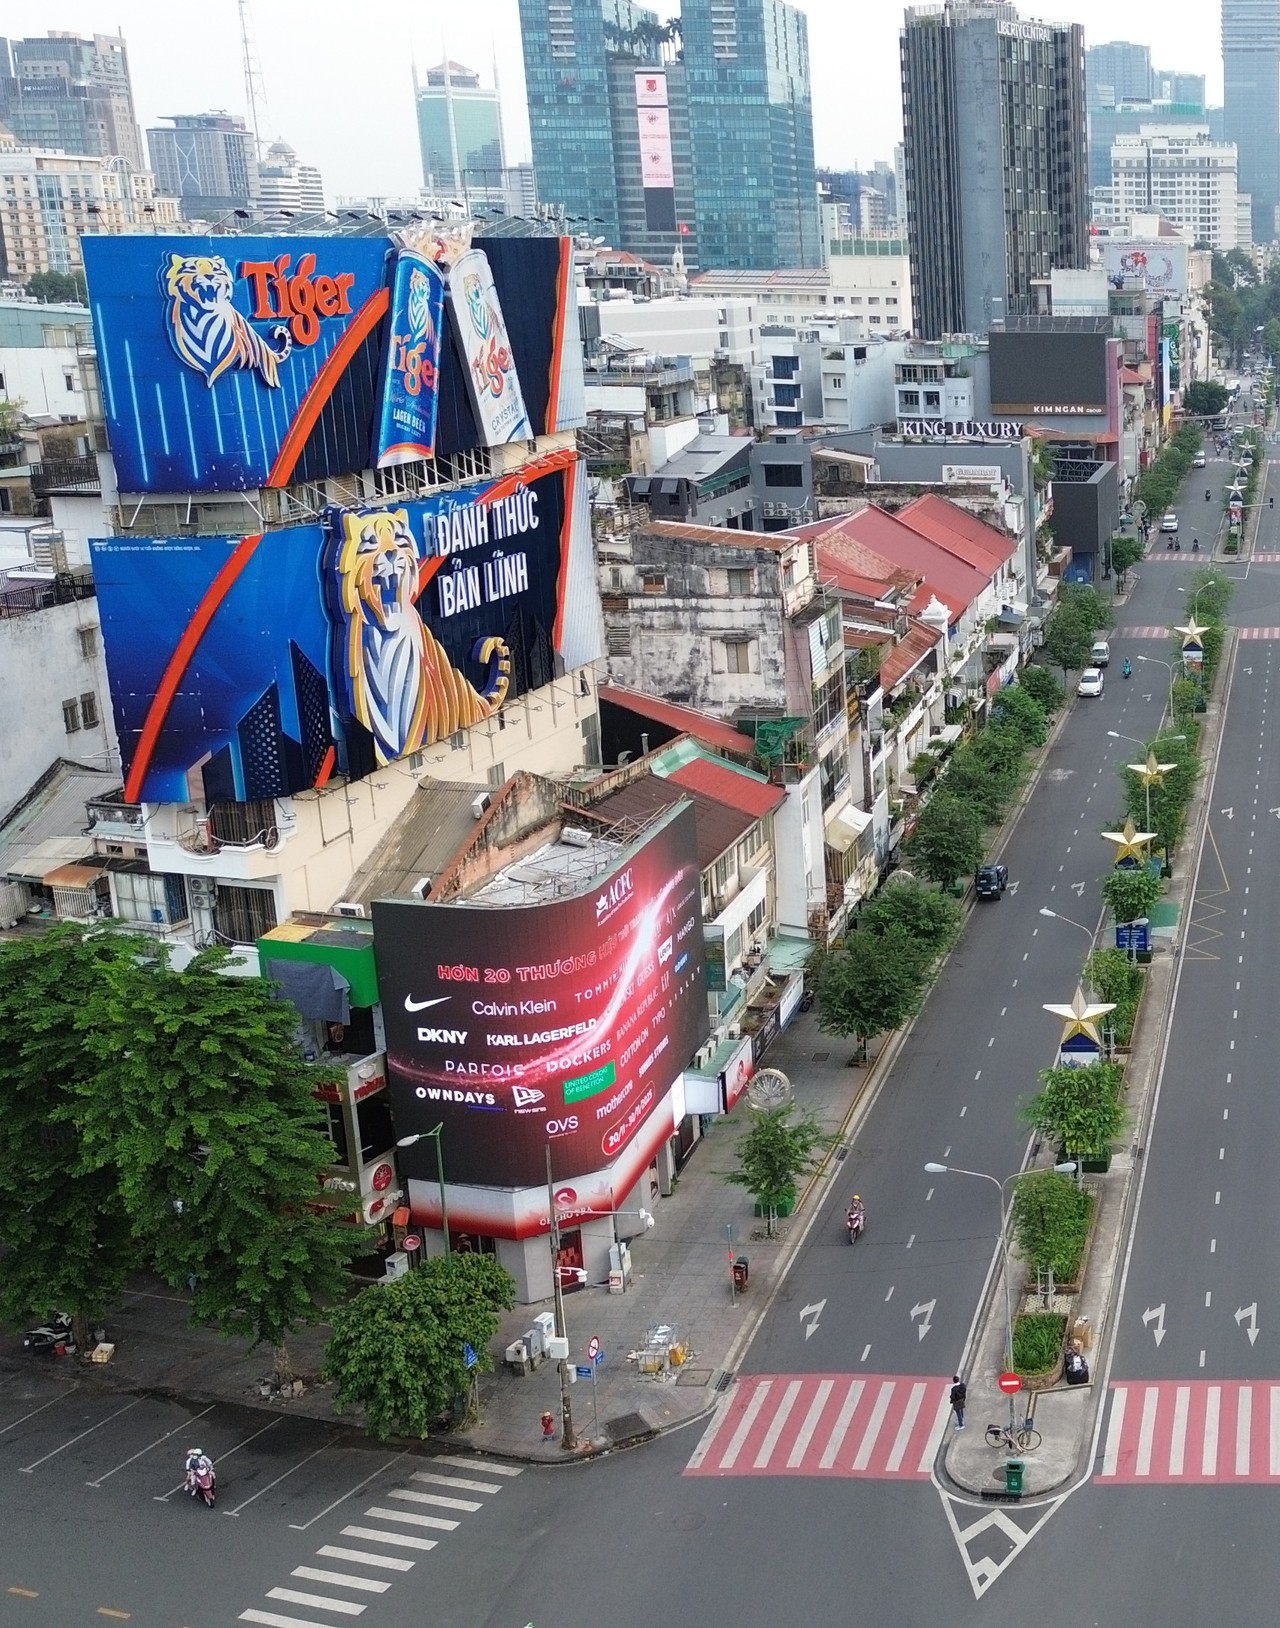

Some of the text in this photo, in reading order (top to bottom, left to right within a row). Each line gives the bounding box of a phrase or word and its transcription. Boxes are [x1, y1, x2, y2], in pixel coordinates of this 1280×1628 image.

[996, 20, 1021, 39] LIBERTY
[241, 253, 355, 346] Tiger
[1033, 405, 1053, 413] KIM
[1055, 405, 1084, 413] NGAN
[902, 421, 1023, 437] KING LUXURY
[434, 480, 539, 558] ĐÁNH THỨC
[438, 557, 481, 618] BẢN
[608, 867, 635, 910] ACFC
[677, 916, 695, 942] MANGO
[437, 964, 480, 983] HƠN
[484, 968, 511, 983] 20
[516, 950, 597, 983] THƯƠNG
[575, 977, 614, 1004] TOMMY
[472, 999, 557, 1017] Calvin Klein
[417, 1027, 468, 1045] DKNY
[486, 1017, 598, 1047] KARL LAGERFELD
[445, 1058, 526, 1077] PARFOIS
[546, 1040, 612, 1073] DOCKERS
[415, 1086, 496, 1105] OWNDAYS
[565, 1076, 589, 1089] UNITED
[596, 1080, 634, 1120] mothercare
[545, 1115, 580, 1134] OVS
